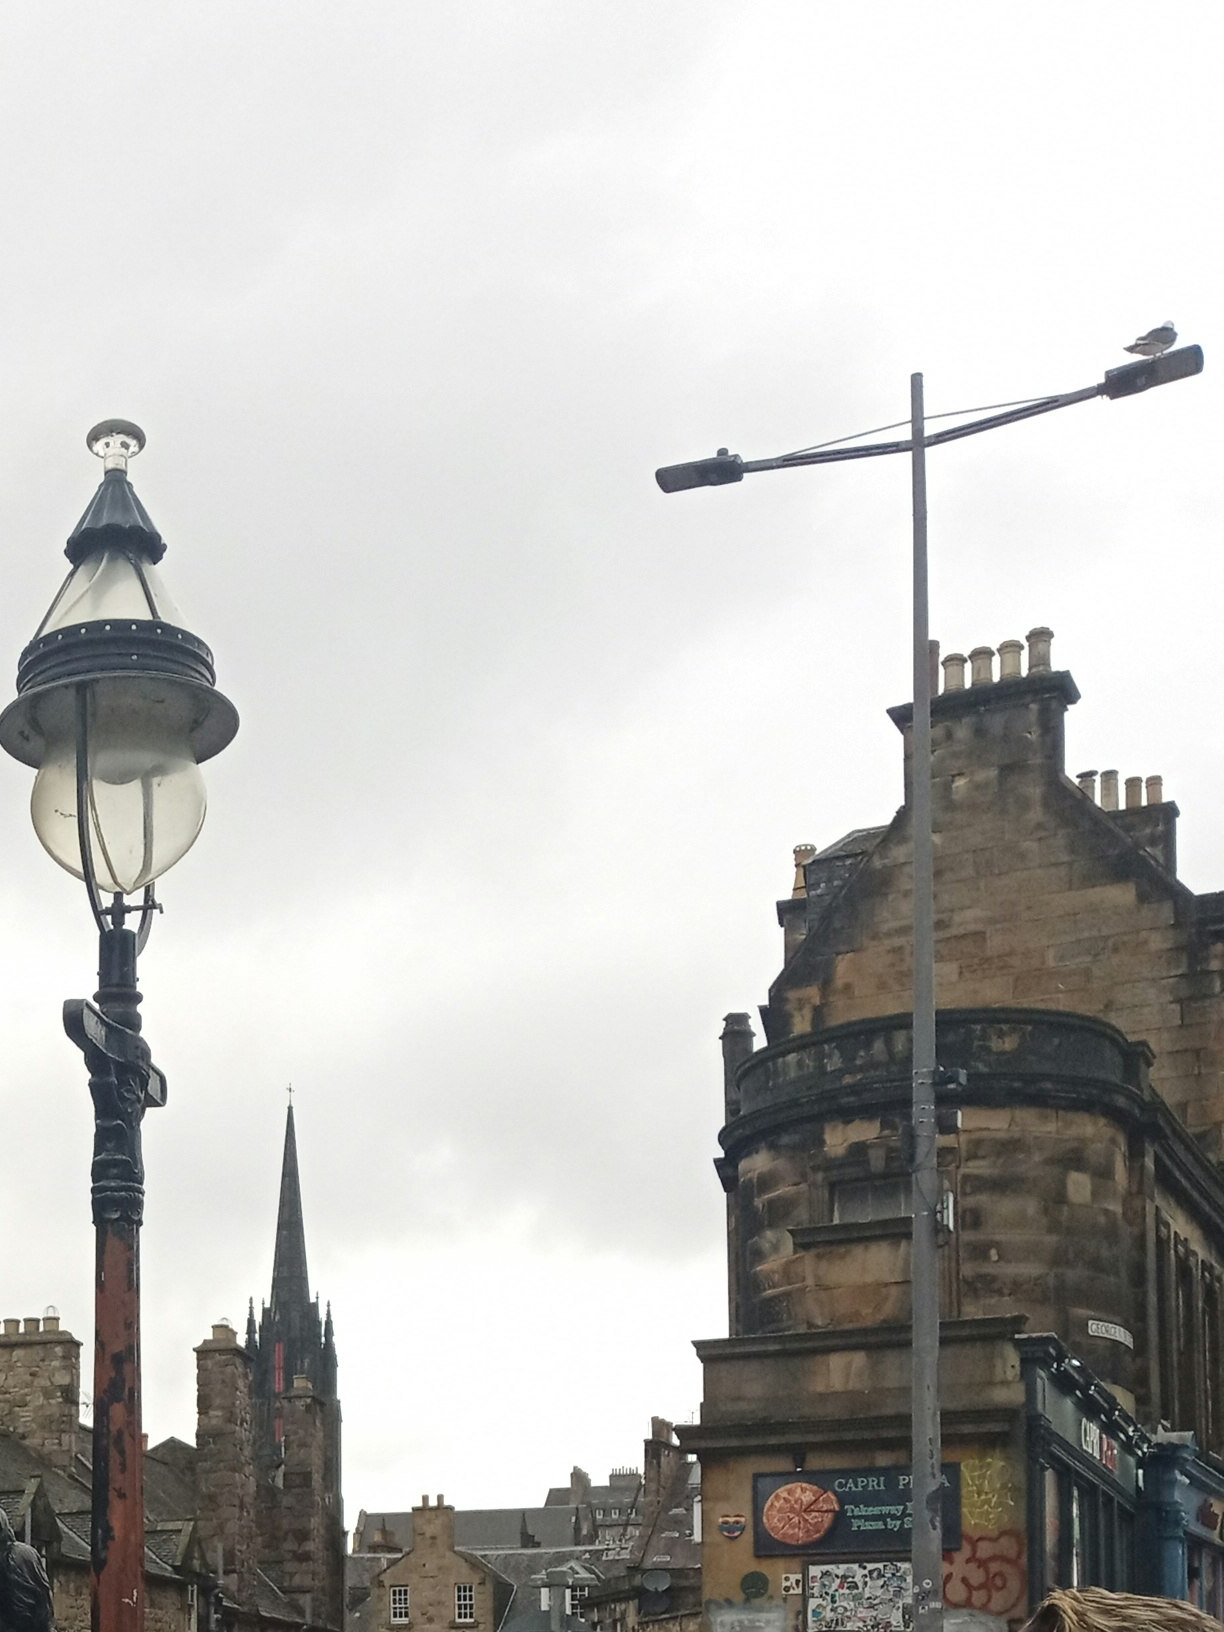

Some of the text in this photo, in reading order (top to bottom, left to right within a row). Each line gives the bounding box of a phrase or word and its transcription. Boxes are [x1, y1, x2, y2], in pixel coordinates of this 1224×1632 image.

[834, 1474, 951, 1492] CAPRI PIA
[844, 1503, 904, 1517] Takeaway
[887, 1518, 902, 1531] by
